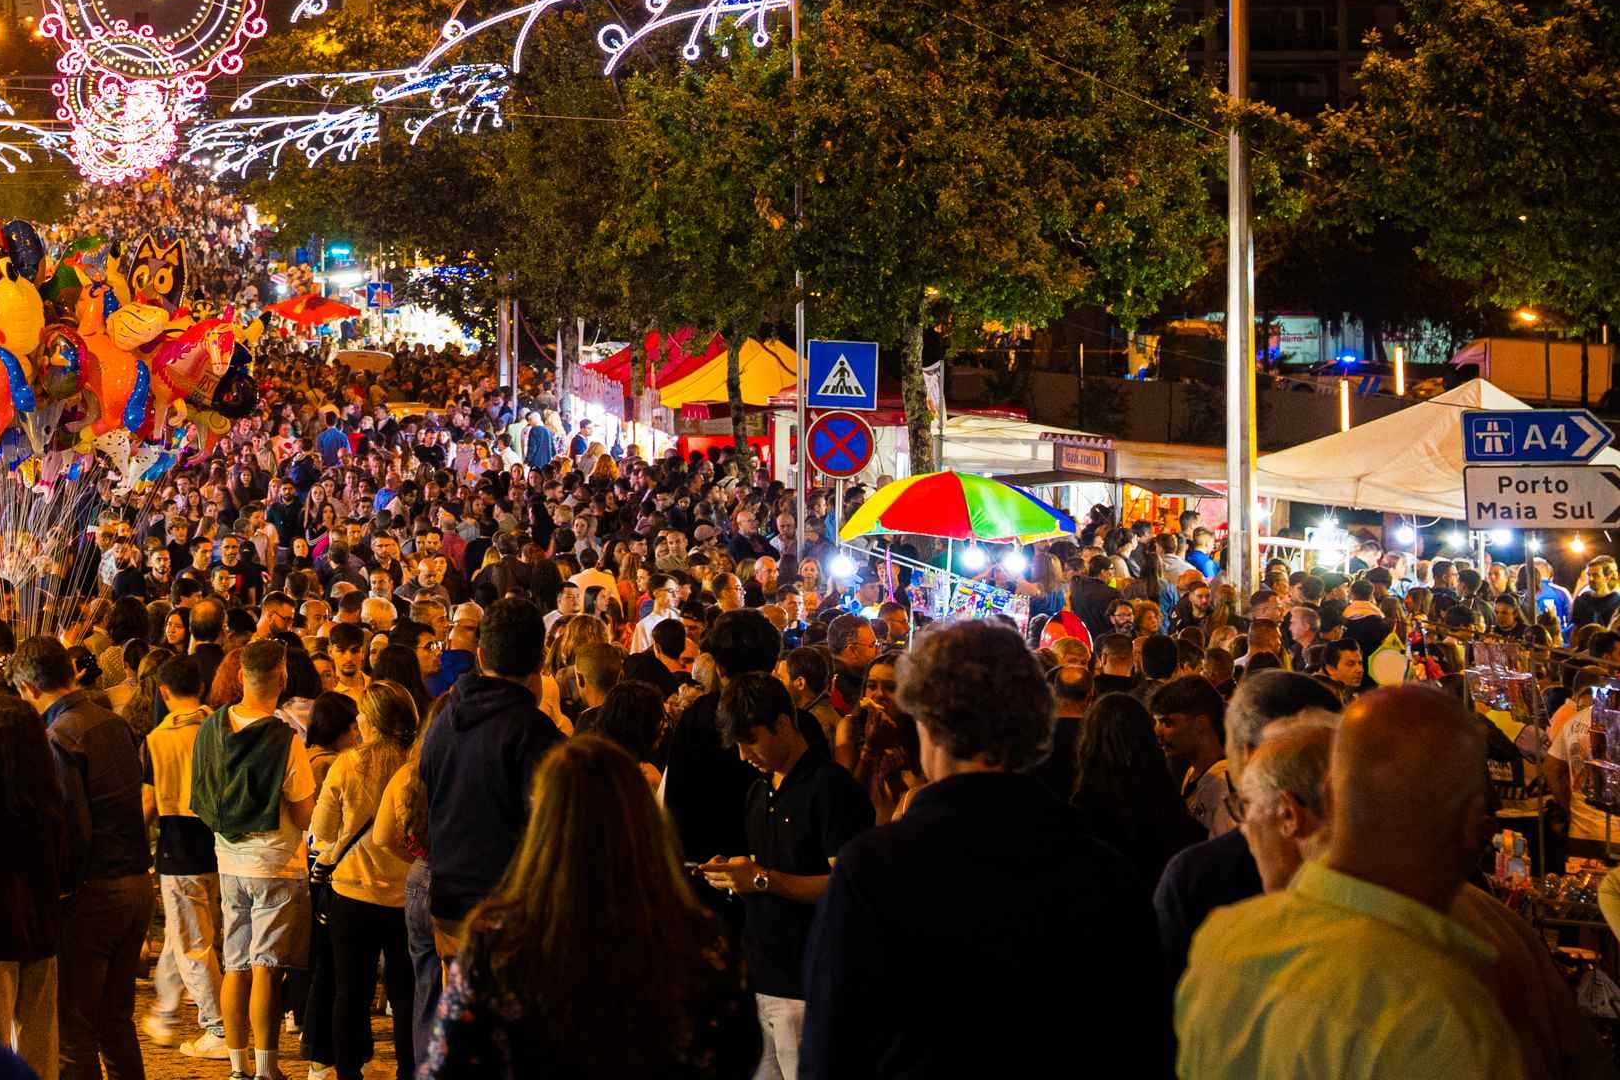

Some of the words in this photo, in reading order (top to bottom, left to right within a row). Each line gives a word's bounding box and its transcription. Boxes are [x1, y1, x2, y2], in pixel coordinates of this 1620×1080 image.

[1522, 424, 1568, 450] A4
[1497, 475, 1569, 494] Porto
[1477, 501, 1538, 520] Maia
[1552, 501, 1595, 520] Sul
